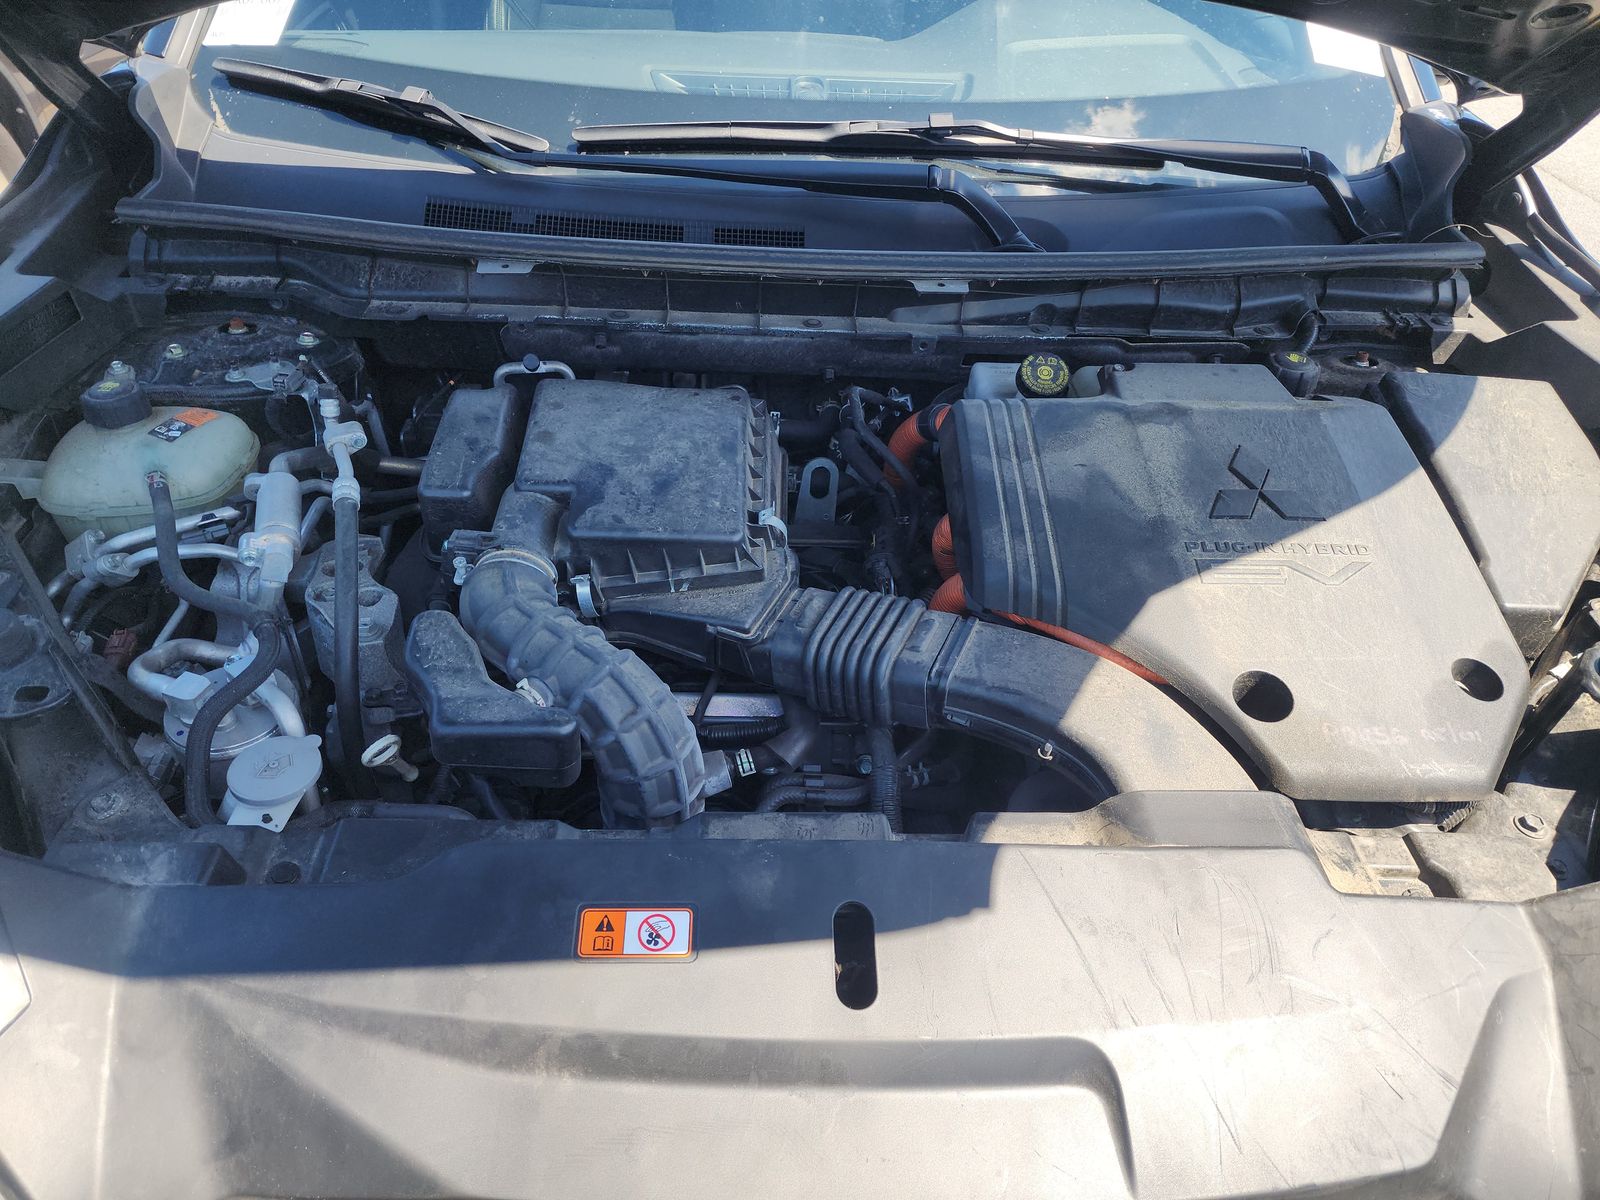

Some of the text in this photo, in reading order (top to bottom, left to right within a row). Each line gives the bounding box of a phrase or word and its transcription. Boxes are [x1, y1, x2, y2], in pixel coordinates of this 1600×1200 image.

[1184, 540, 1371, 556] PLUG-IN HYBRID
[1194, 557, 1372, 586] EV
